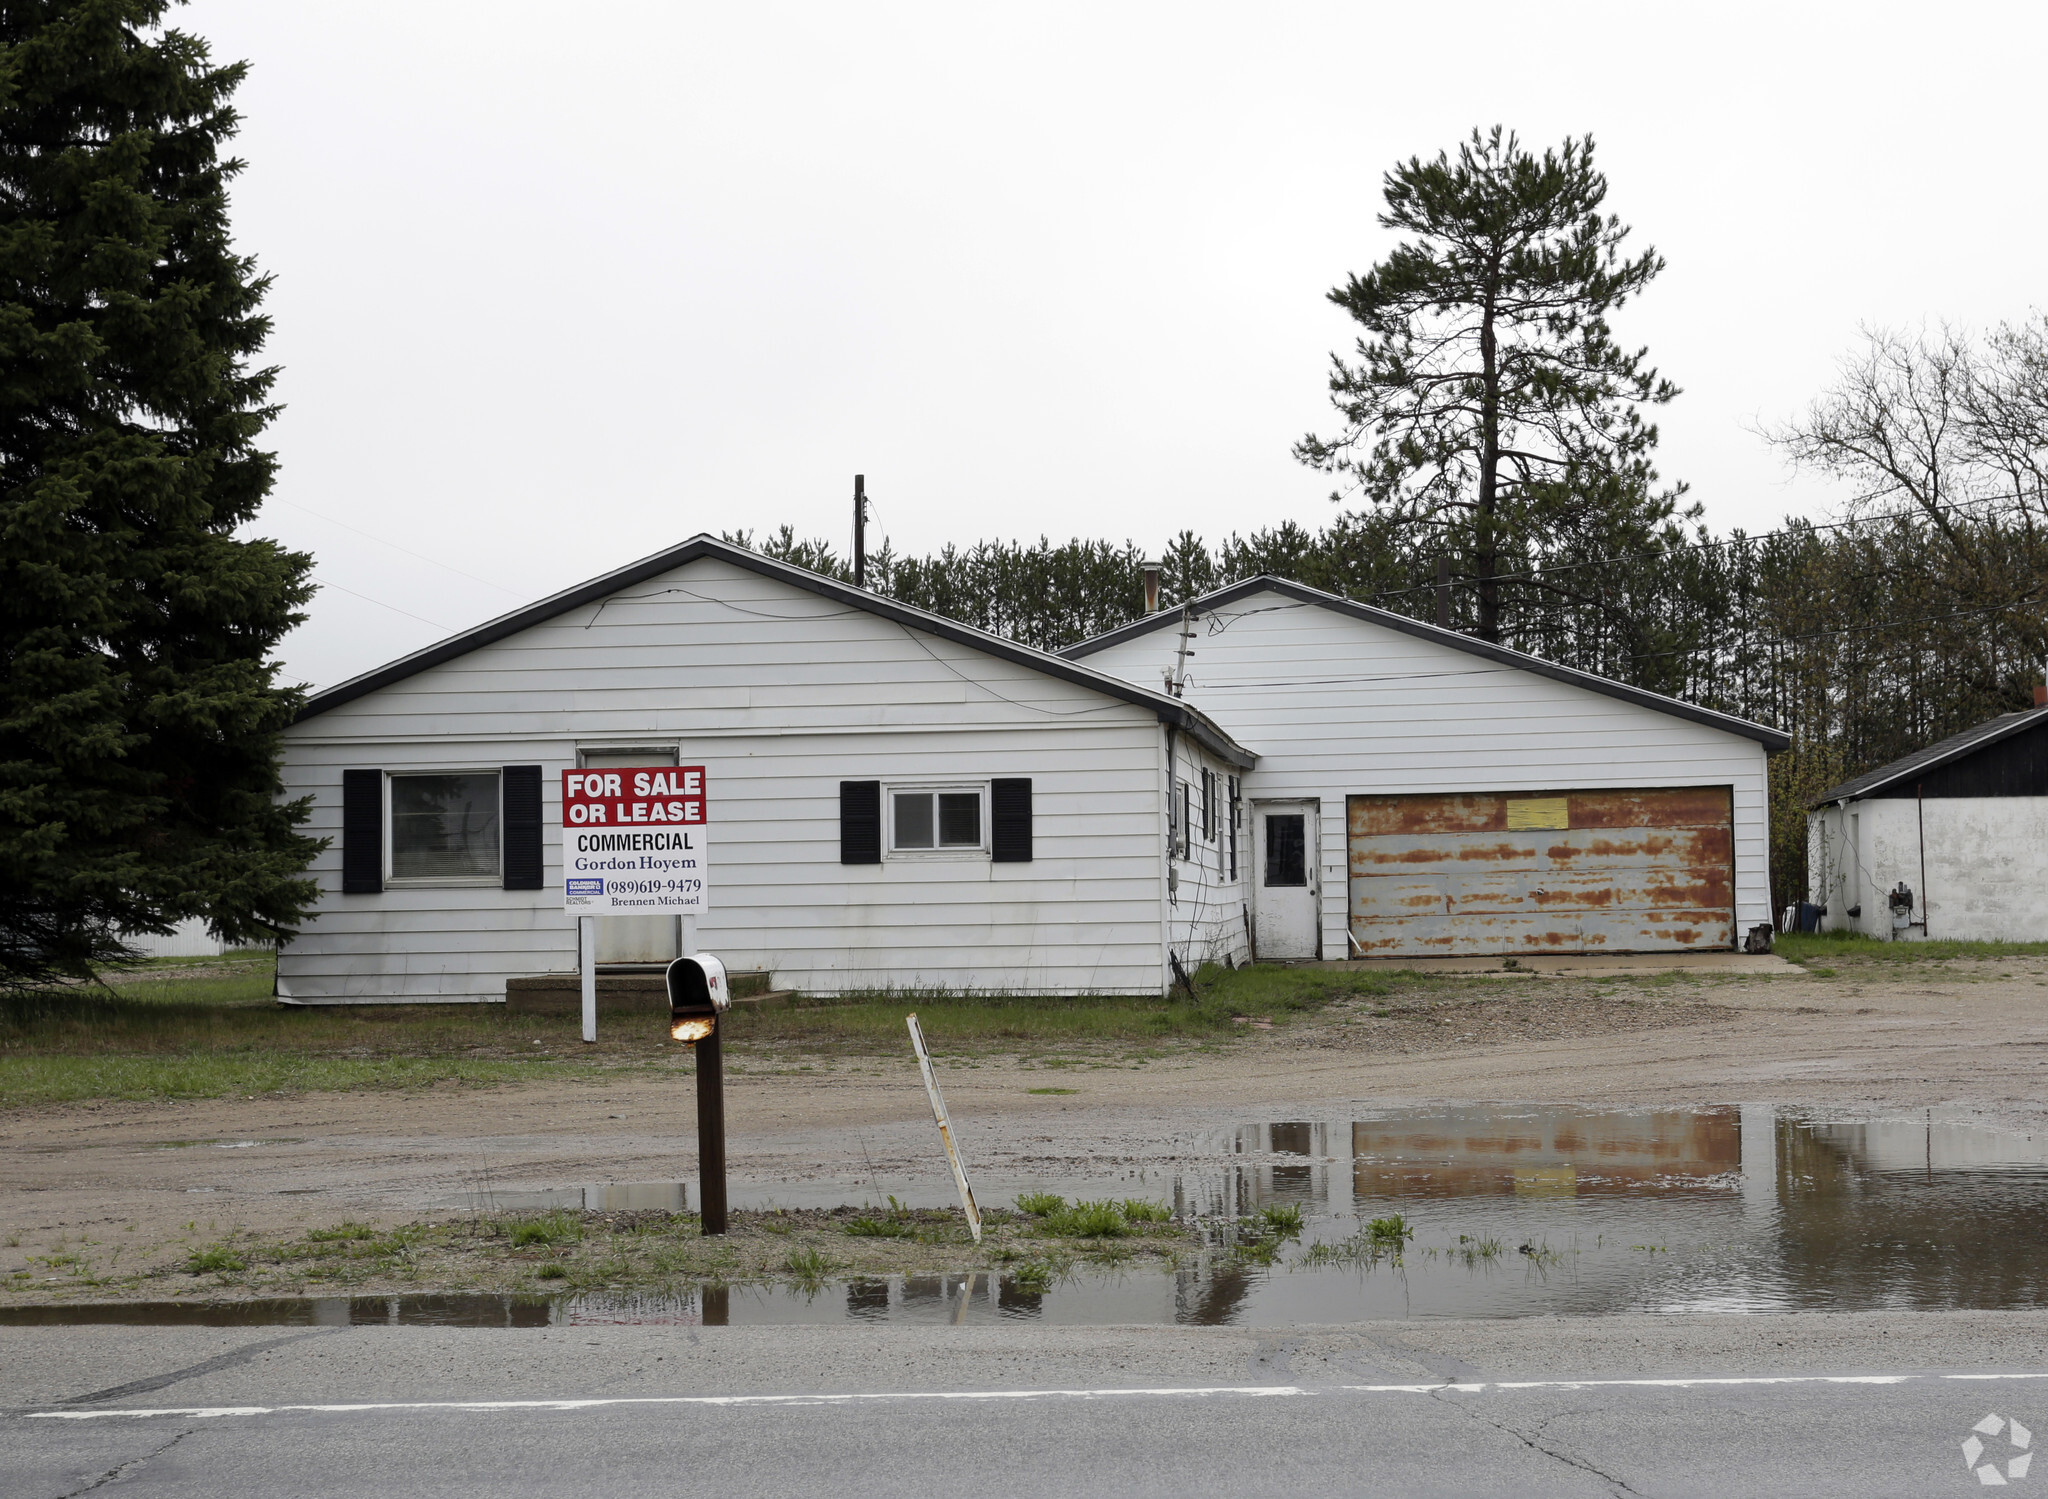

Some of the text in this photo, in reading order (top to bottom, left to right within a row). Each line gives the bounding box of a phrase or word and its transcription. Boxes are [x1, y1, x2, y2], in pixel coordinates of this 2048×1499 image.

[567, 771, 701, 798] FOR SALE
[568, 801, 701, 824] OR LEASE
[577, 832, 694, 852] COMMERCIAL
[574, 855, 697, 873] Gordon Hoyem
[606, 878, 702, 895] (989)619-9479
[611, 895, 700, 907] Brennen Michael
